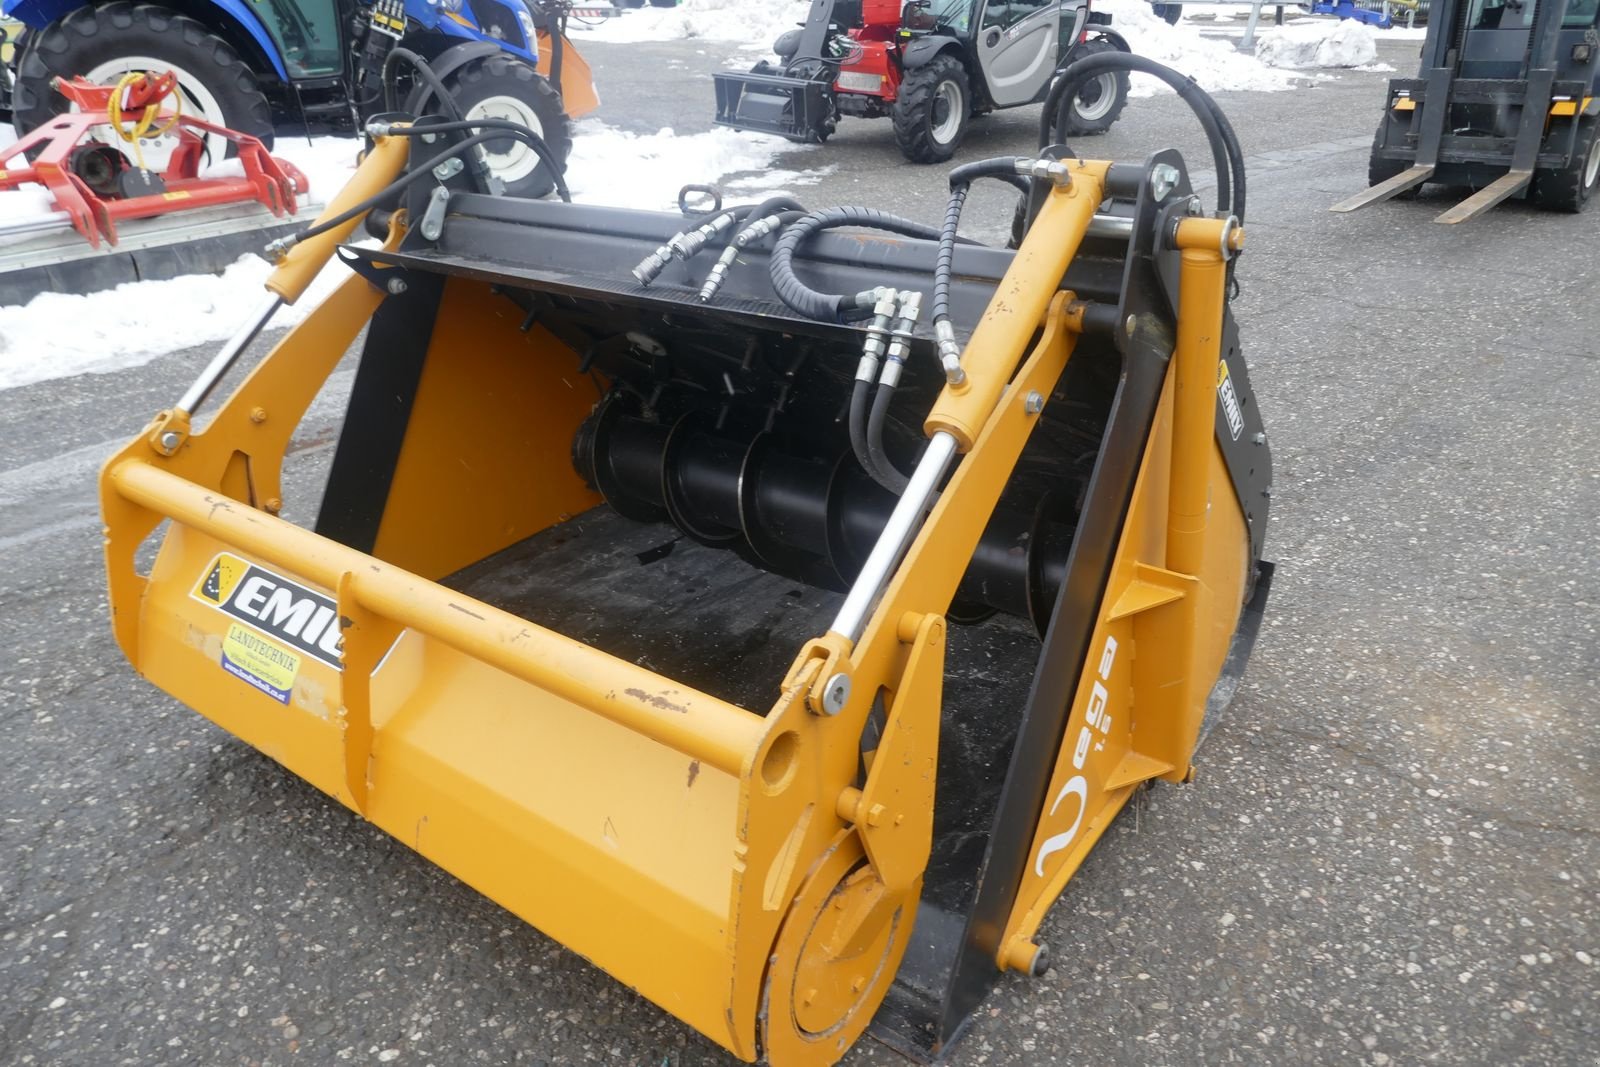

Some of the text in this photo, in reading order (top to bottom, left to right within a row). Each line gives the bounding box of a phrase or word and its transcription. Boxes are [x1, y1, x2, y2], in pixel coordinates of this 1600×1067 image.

[1221, 379, 1242, 434] EMILY
[234, 576, 344, 656] EMIL
[230, 627, 297, 672] LANDTECHNIK
